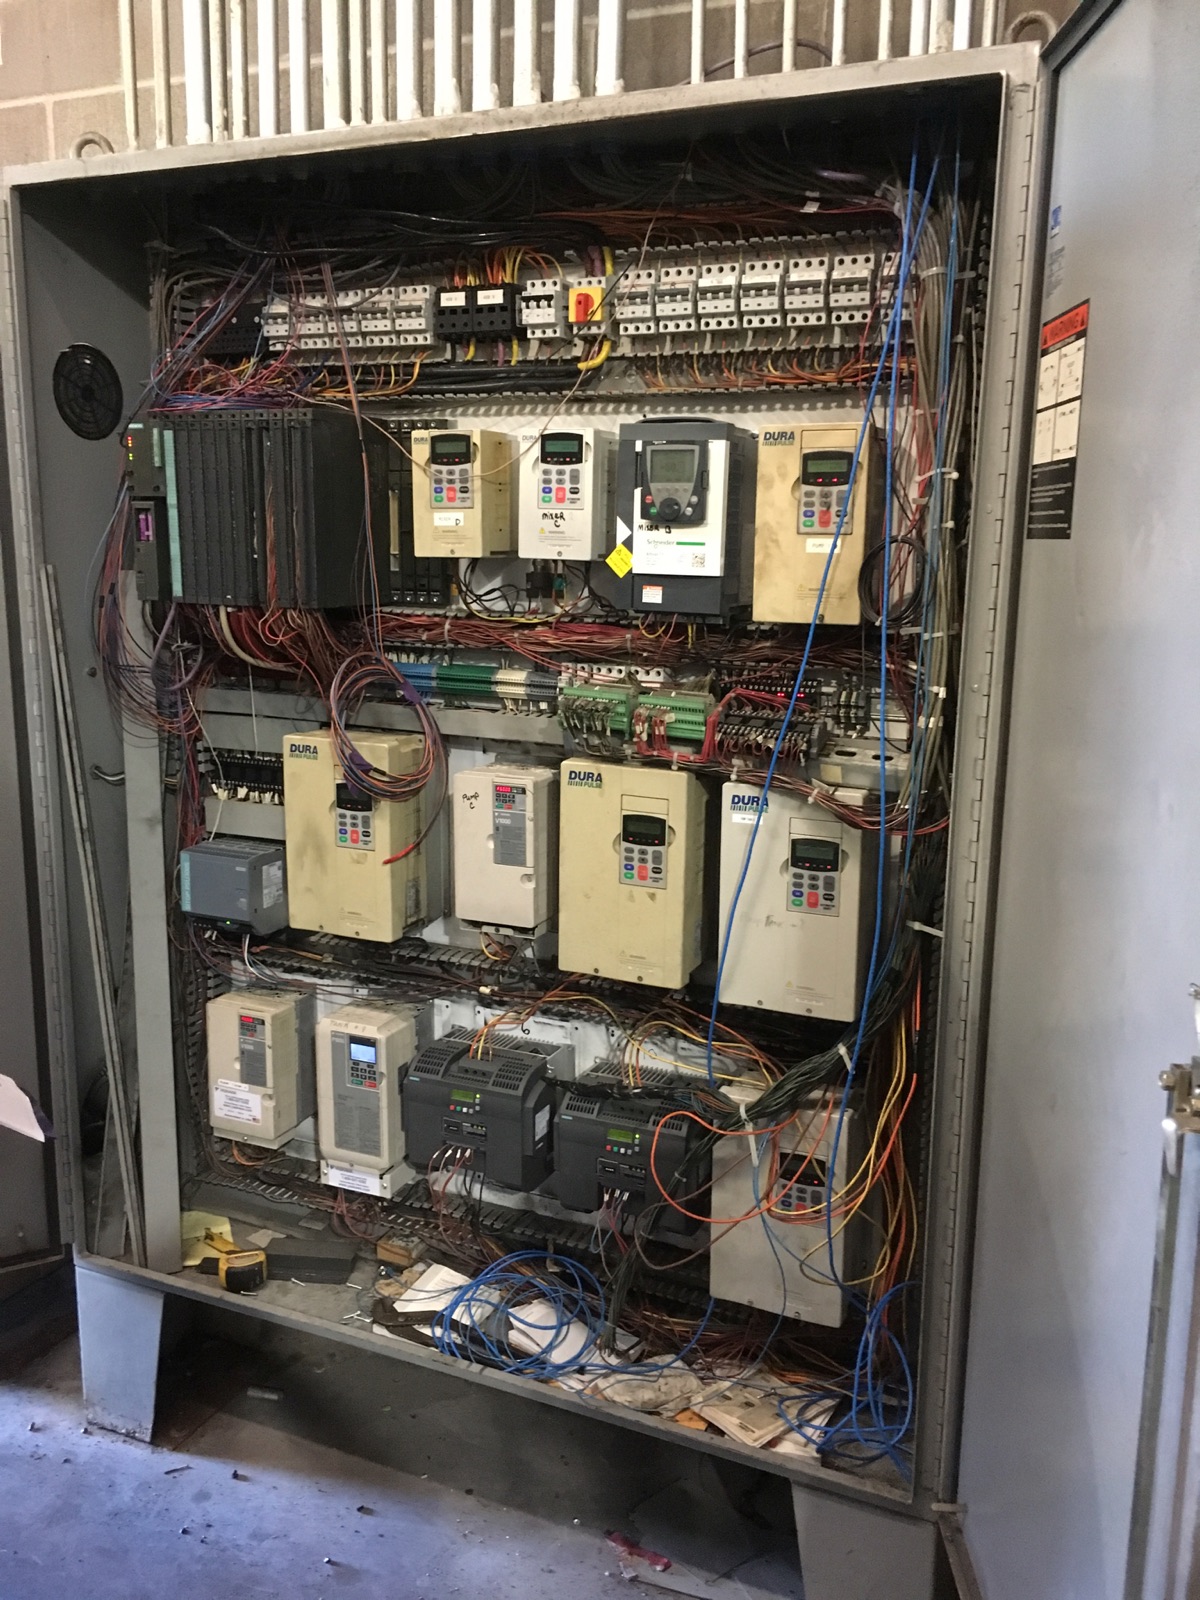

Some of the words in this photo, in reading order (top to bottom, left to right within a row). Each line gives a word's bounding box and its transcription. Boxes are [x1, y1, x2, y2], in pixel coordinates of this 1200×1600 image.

[763, 431, 795, 441] DURA
[290, 743, 318, 755] DURA
[568, 770, 602, 783] DURA
[583, 781, 602, 789] PULSE
[731, 795, 768, 807] DURA
